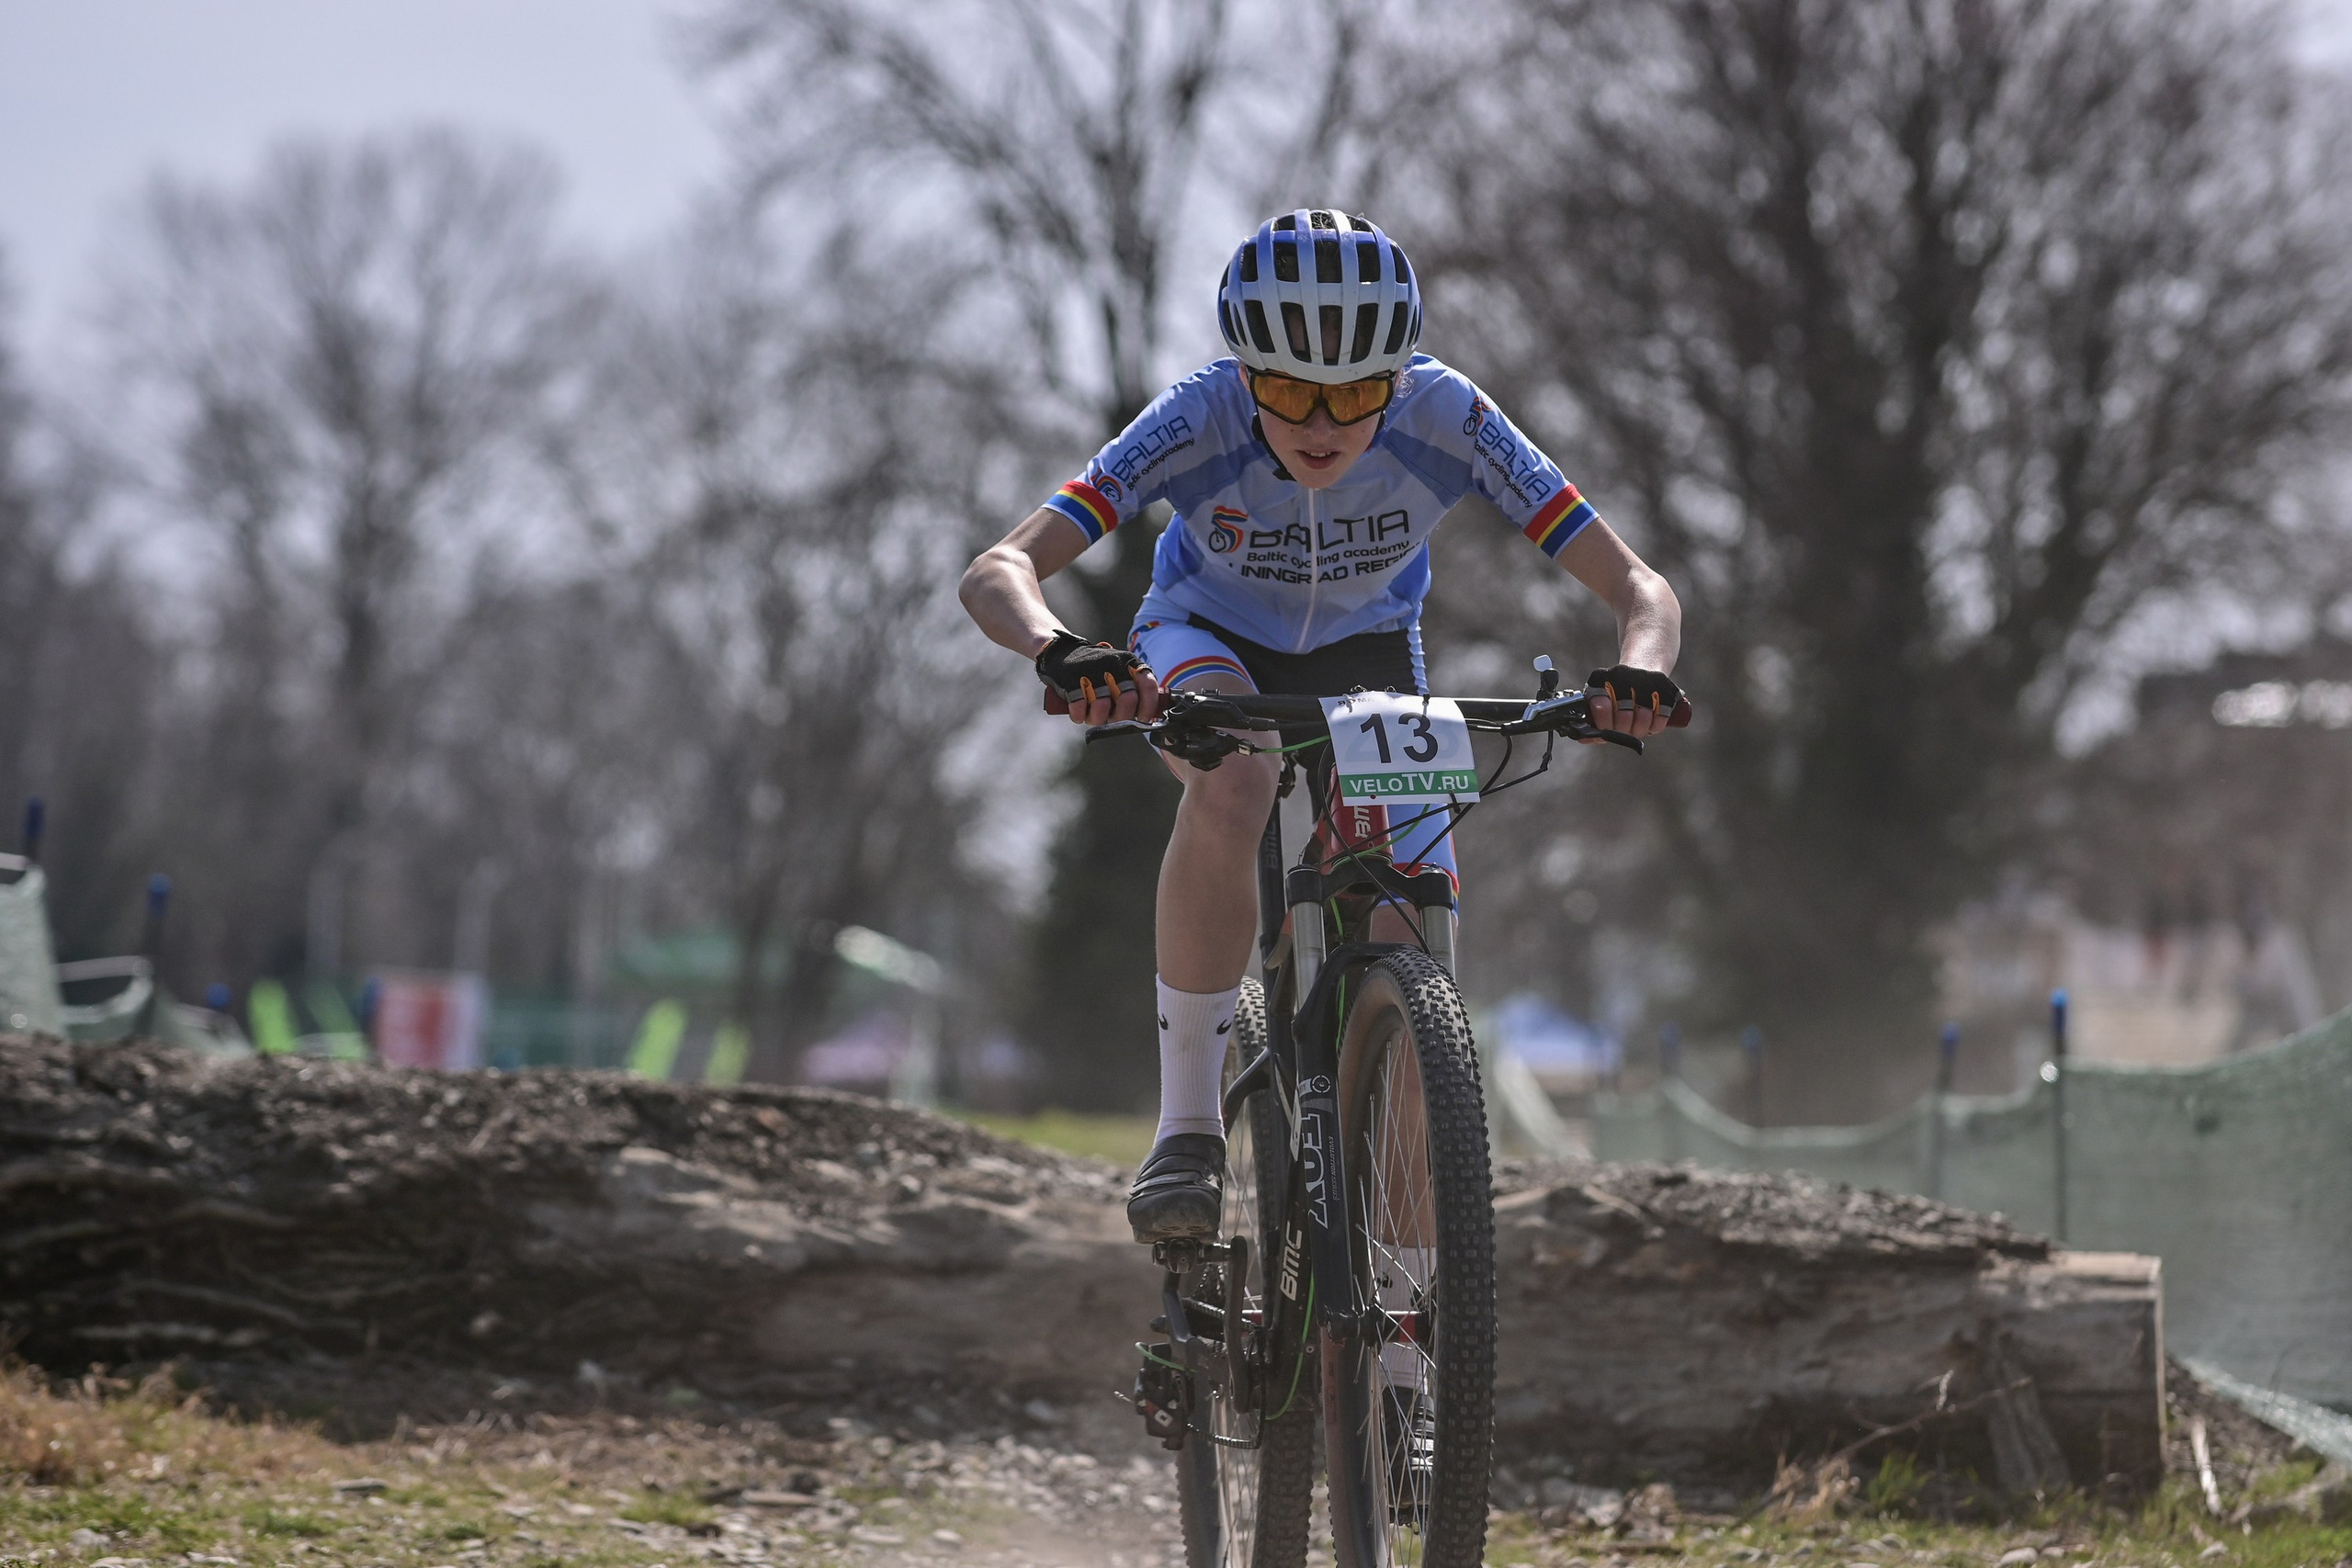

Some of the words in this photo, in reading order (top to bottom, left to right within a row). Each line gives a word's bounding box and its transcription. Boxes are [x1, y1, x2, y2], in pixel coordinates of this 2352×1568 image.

[1111, 416, 1192, 483] BALTIA
[1478, 421, 1551, 502] BALTIA
[1247, 552, 1288, 562] Baltic
[1343, 540, 1409, 558] academy
[1250, 509, 1409, 553] BALTIA
[1360, 712, 1439, 763] 13
[1350, 773, 1469, 794] VELOTV.RU
[1353, 805, 1371, 839] BM
[1280, 1221, 1303, 1302] BMC
